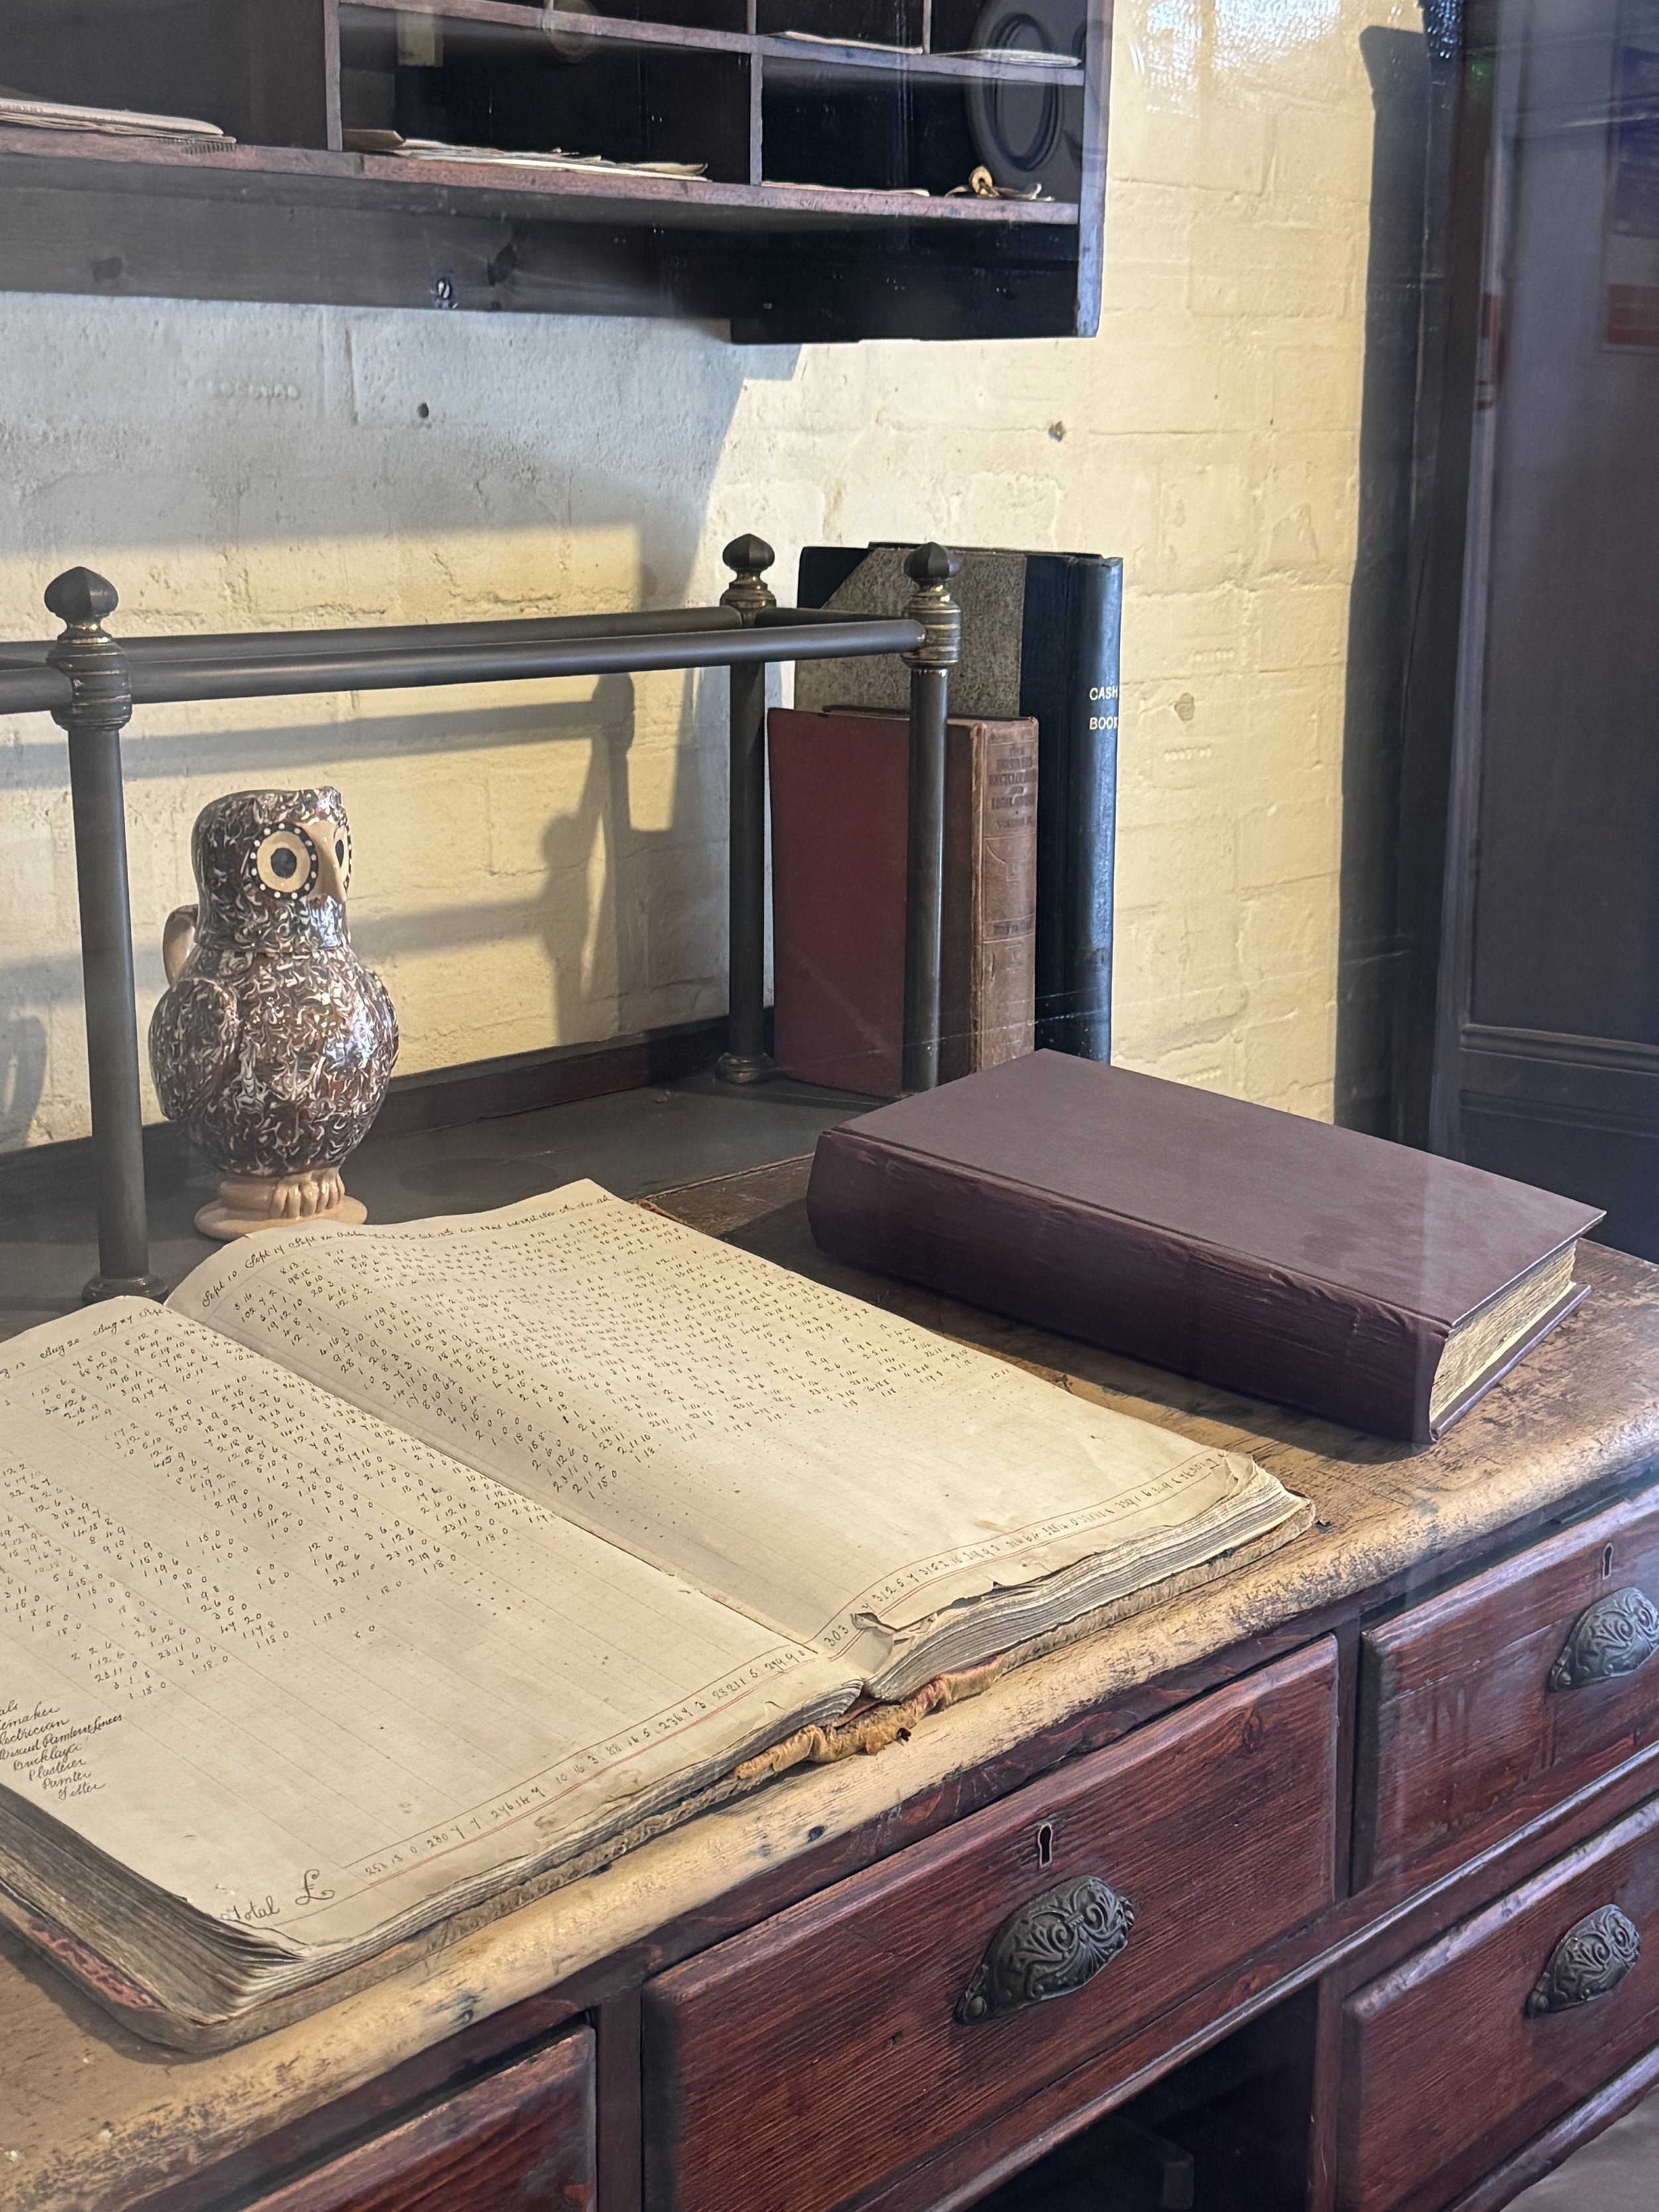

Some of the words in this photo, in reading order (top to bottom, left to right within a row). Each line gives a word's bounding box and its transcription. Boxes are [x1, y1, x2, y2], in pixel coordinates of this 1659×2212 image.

[1089, 686, 1118, 701] CASH
[93, 1322, 117, 1335] Aug
[220, 1895, 279, 1920] Total
[295, 1869, 334, 1905] £
